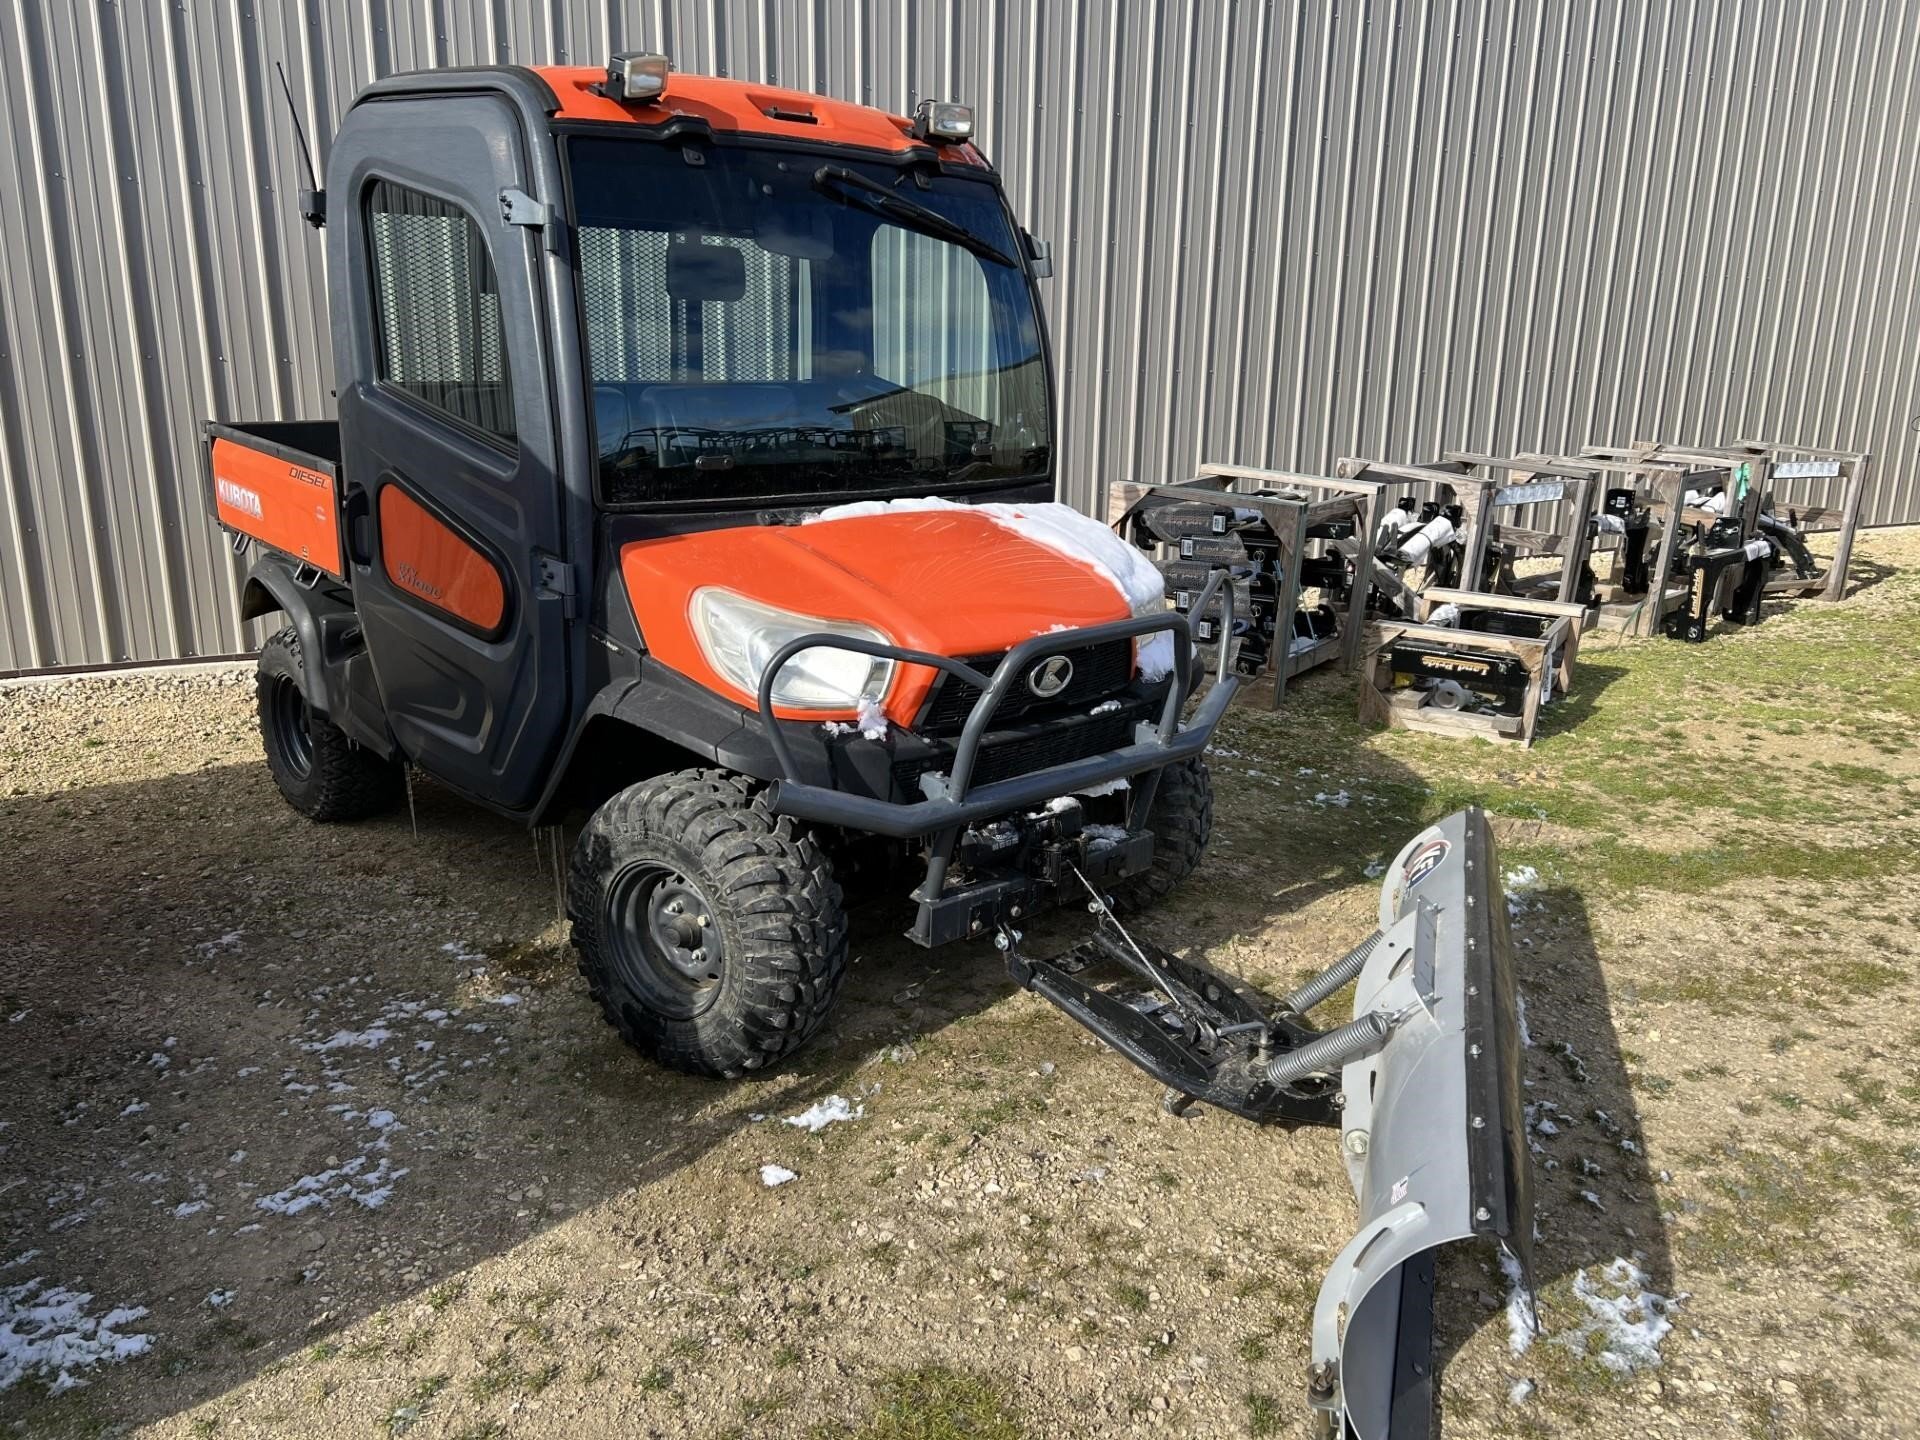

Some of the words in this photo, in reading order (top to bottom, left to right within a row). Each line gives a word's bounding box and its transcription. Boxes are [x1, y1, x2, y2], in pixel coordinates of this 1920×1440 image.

[289, 466, 327, 490] DIESEL
[218, 478, 263, 519] KUBOTA
[1457, 664, 1489, 676] Land
